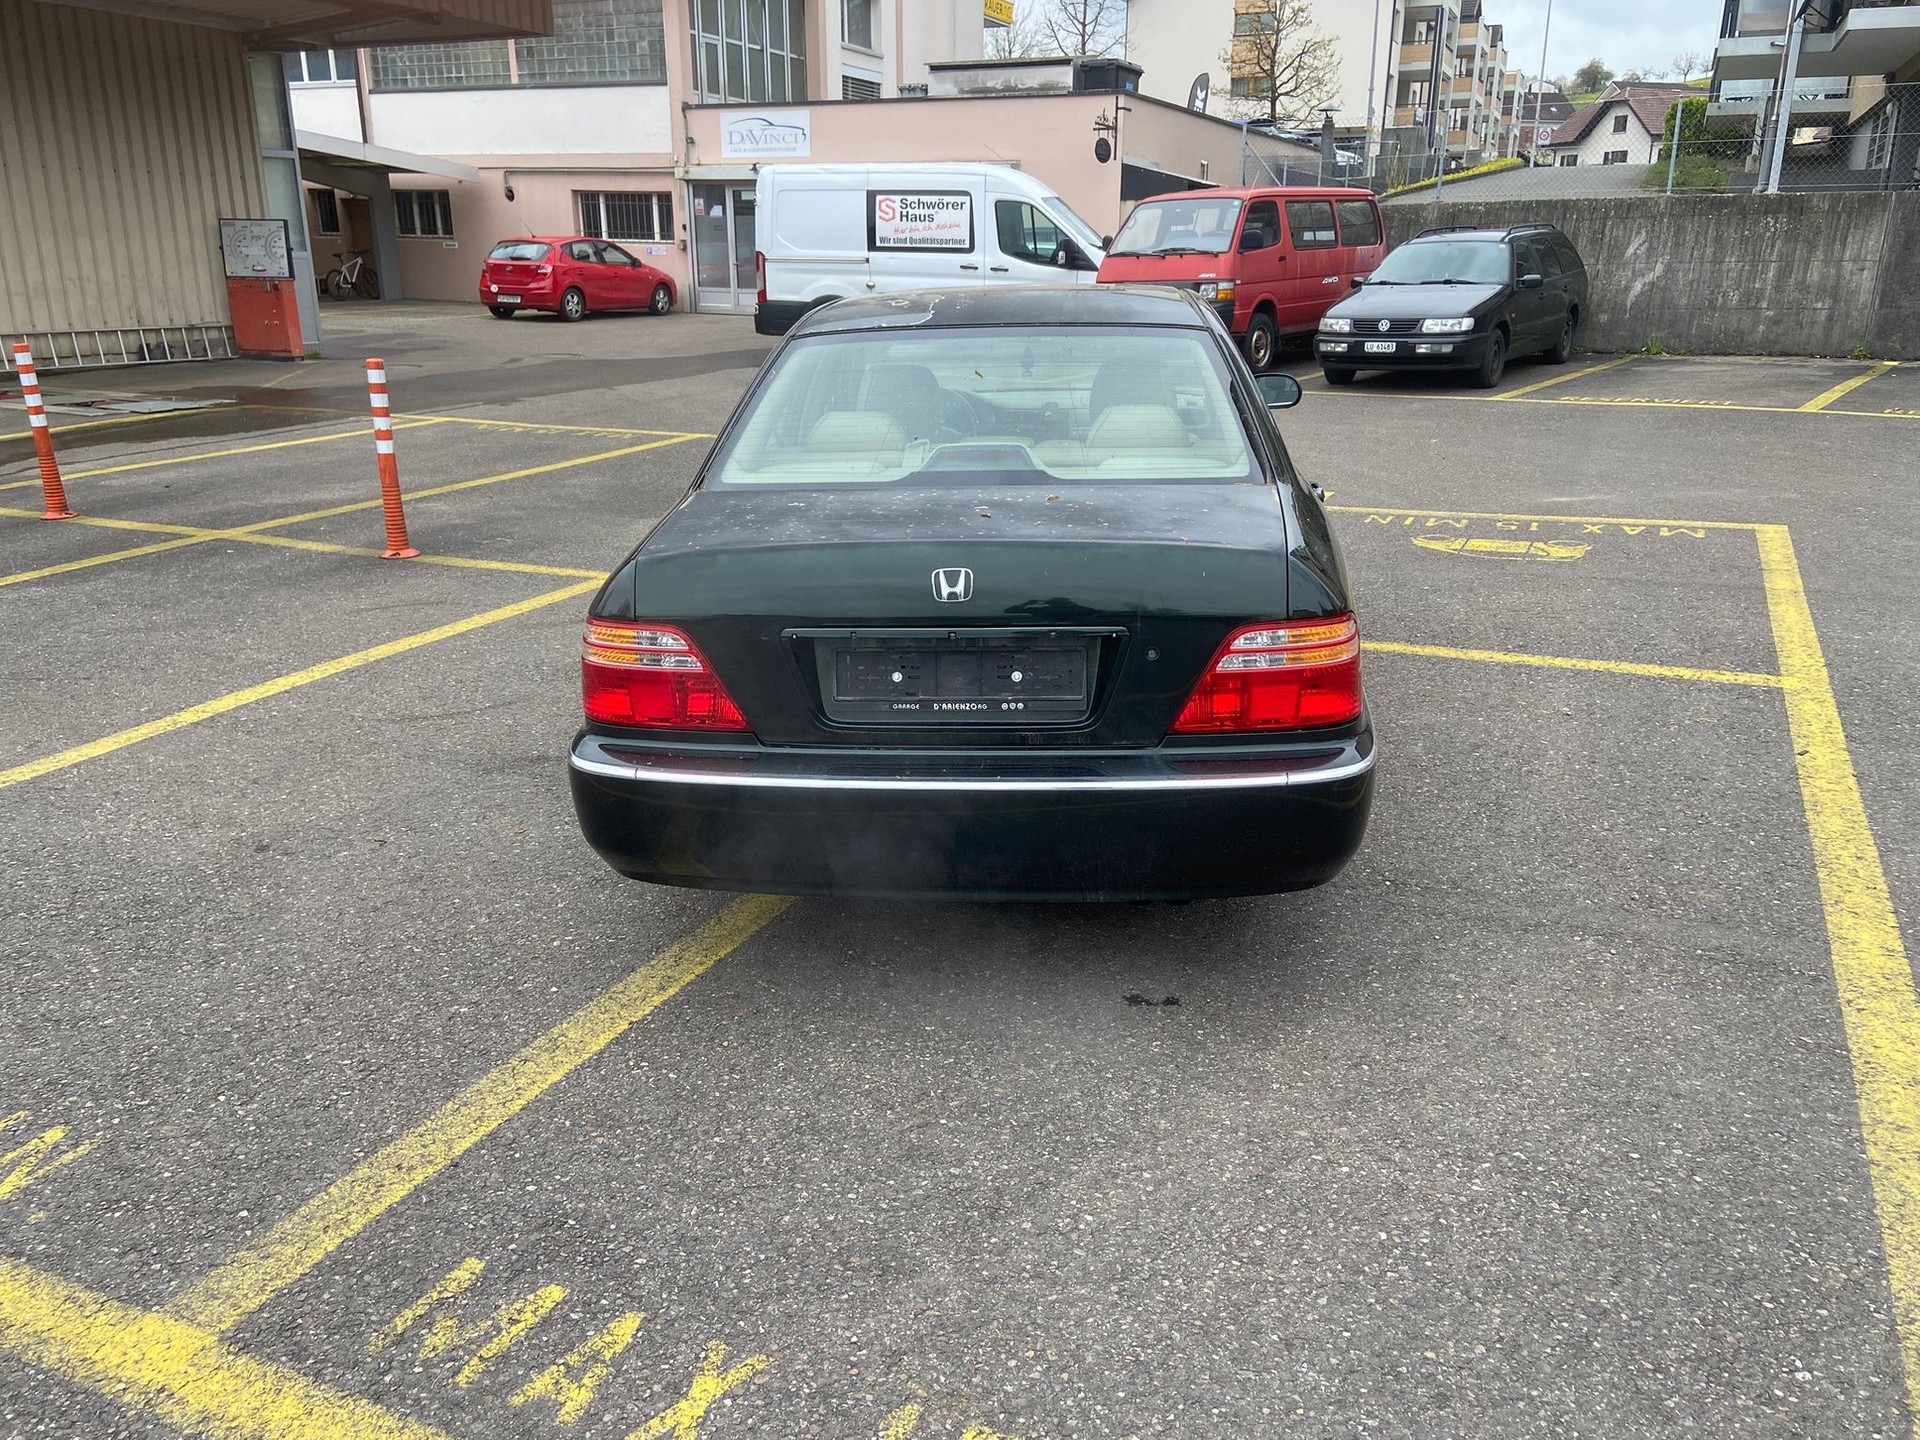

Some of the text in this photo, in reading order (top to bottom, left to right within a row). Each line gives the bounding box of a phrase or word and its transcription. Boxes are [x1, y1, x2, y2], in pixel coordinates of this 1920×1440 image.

[899, 198, 966, 210] Schwörer
[899, 210, 935, 222] Haus
[879, 236, 891, 245] Wir
[893, 236, 907, 245] sind
[1363, 514, 1469, 528] MIN
